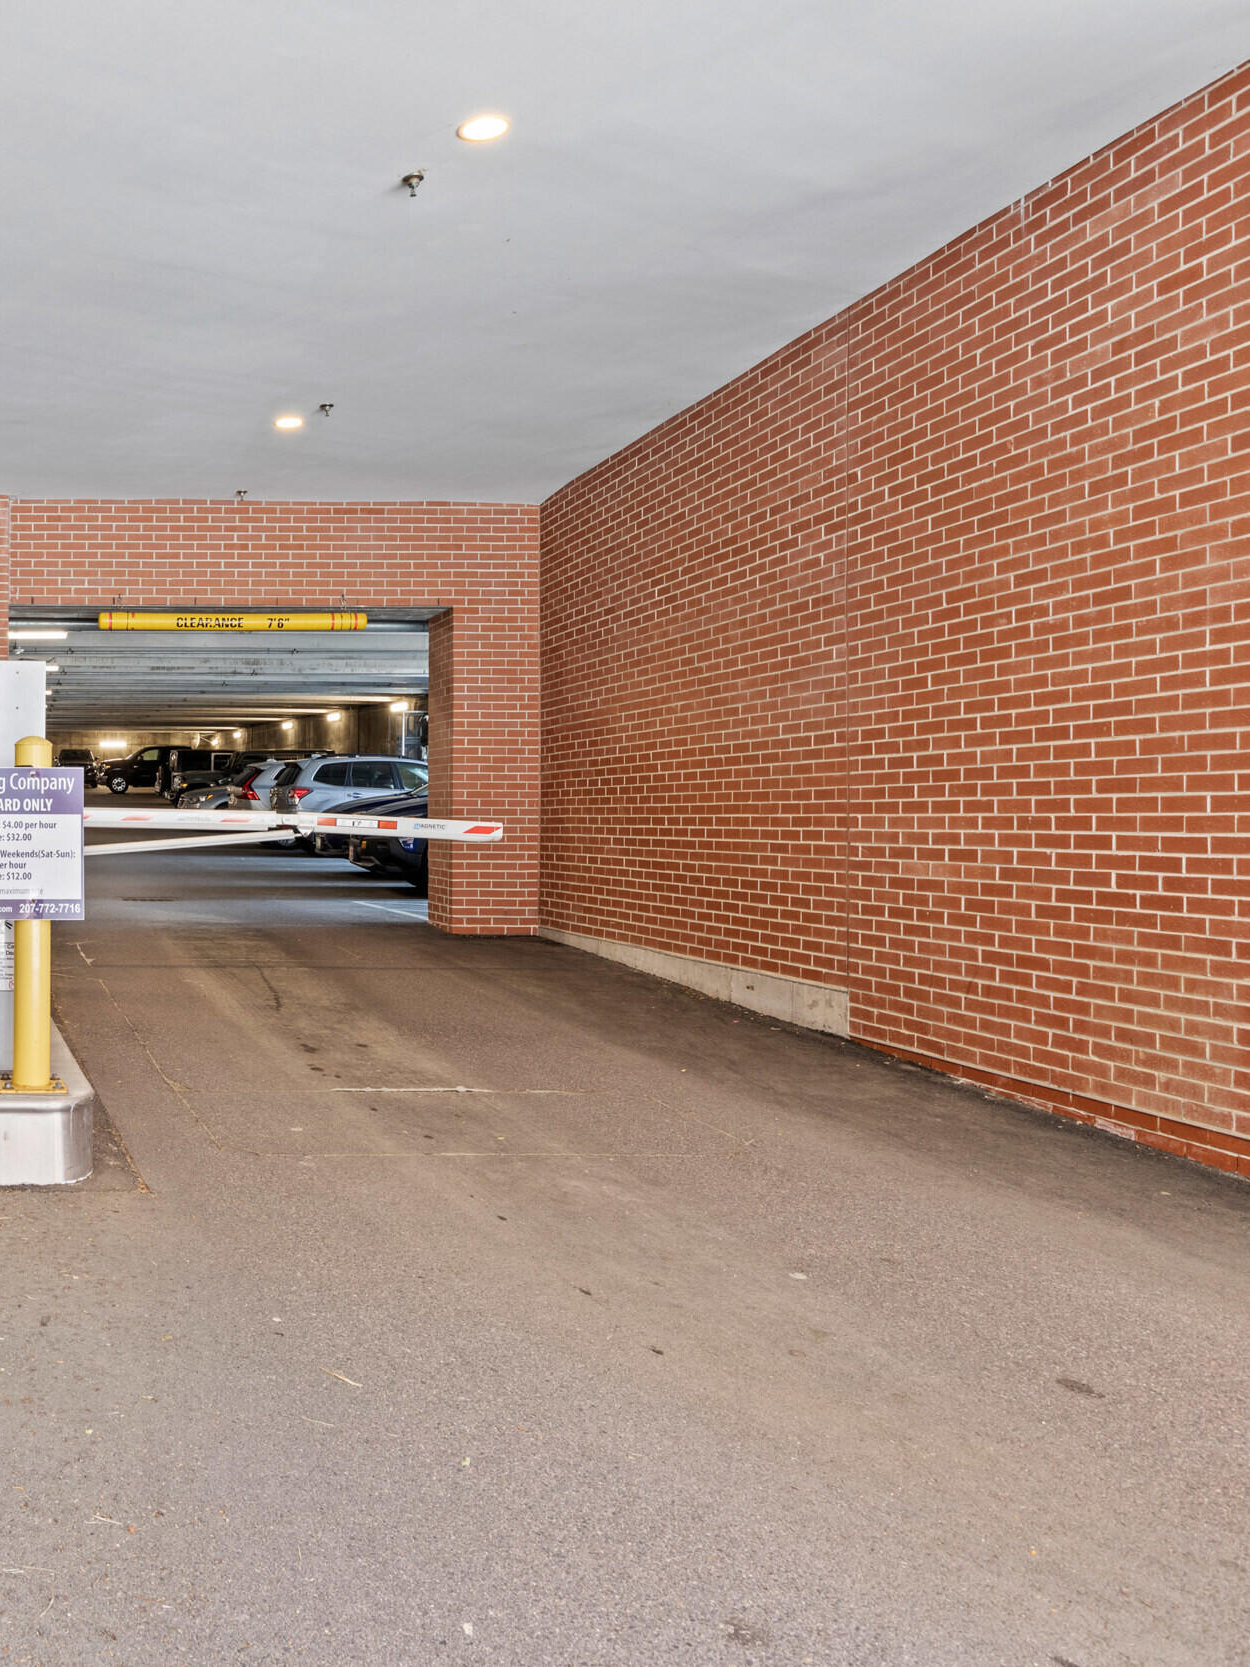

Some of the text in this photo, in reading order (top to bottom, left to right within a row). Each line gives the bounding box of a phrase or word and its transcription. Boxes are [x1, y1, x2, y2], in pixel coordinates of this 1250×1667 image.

[176, 617, 244, 628] CLEARANCE
[10, 772, 75, 794] Company
[23, 798, 53, 812] ONLY
[24, 822, 38, 830] per
[38, 820, 57, 829] hour
[6, 832, 32, 842] $32.00
[8, 861, 26, 869] hour
[6, 872, 32, 880] $12.00
